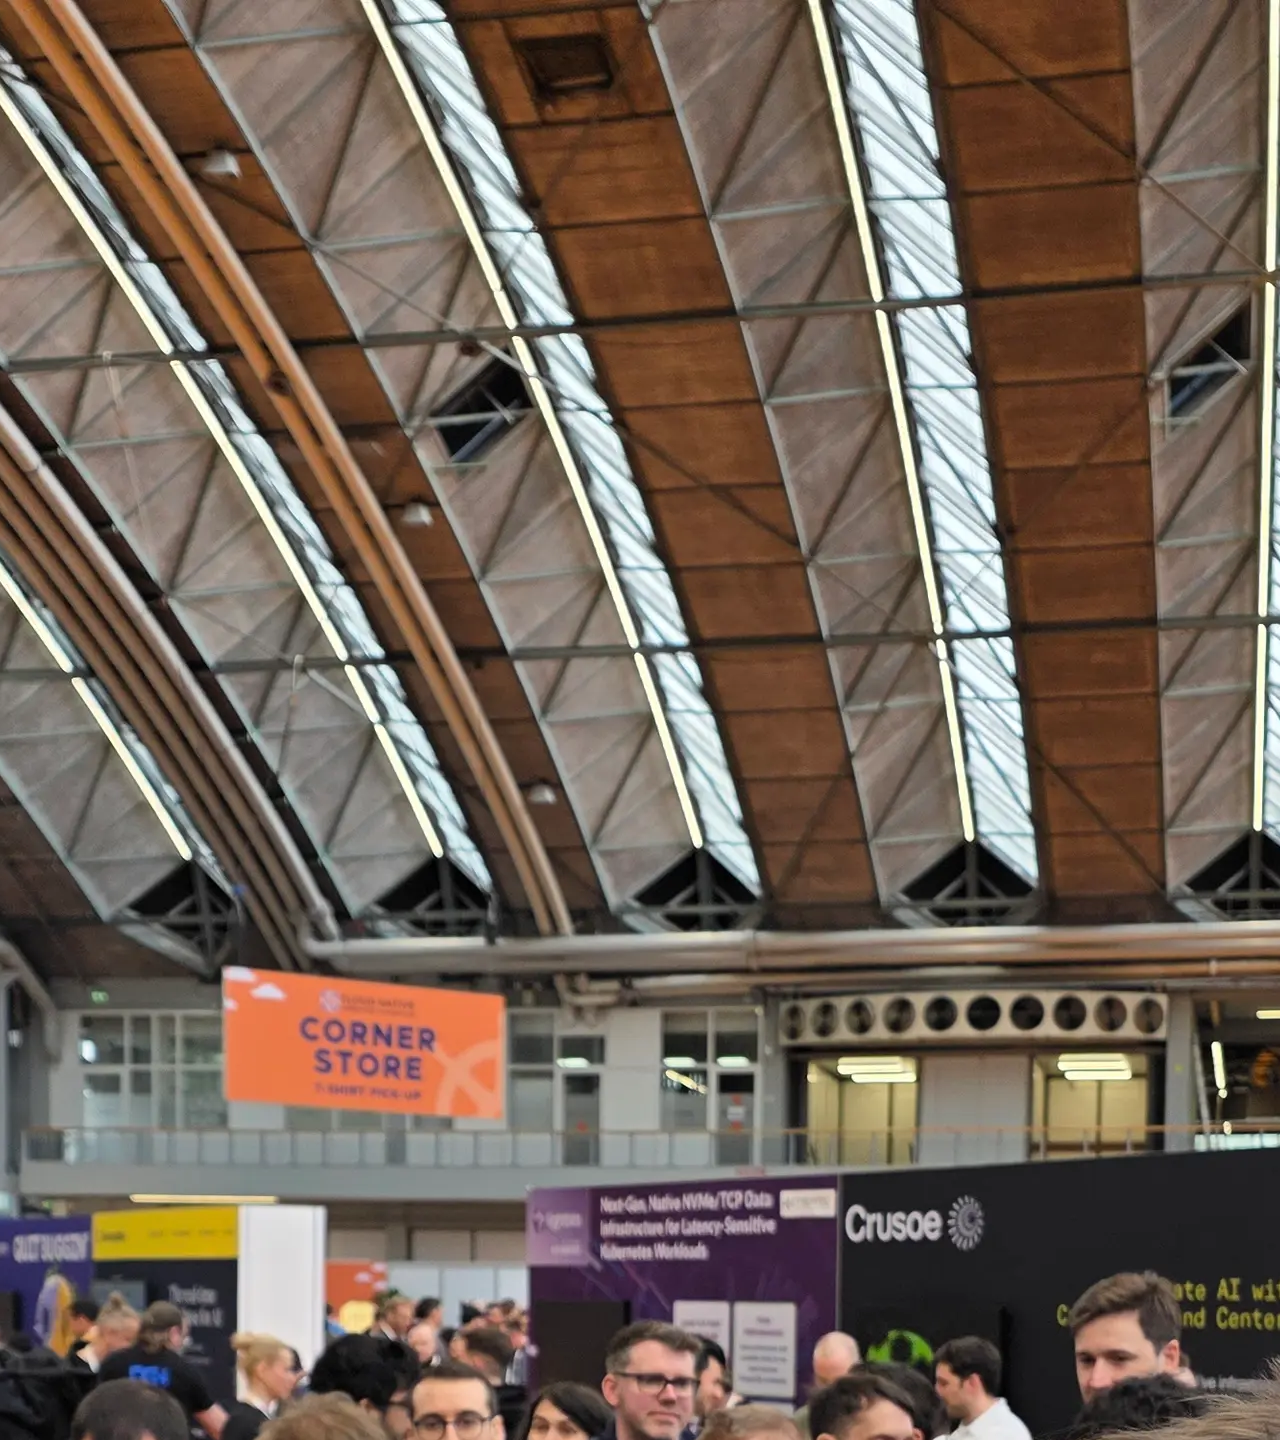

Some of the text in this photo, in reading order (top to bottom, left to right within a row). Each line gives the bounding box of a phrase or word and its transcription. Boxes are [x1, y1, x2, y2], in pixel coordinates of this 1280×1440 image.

[300, 1016, 436, 1053] CORNER
[314, 1048, 422, 1081] STORE
[315, 1082, 365, 1097] T-SHIRT
[744, 1189, 775, 1210] Data
[600, 1218, 664, 1238] Infrastructure
[665, 1216, 681, 1236] for
[681, 1214, 777, 1239] Latency-Sensitive
[845, 1204, 943, 1243] Crusoe
[600, 1242, 653, 1261] Kubernetes
[654, 1240, 710, 1261] Workloads
[1217, 1277, 1241, 1300] AI
